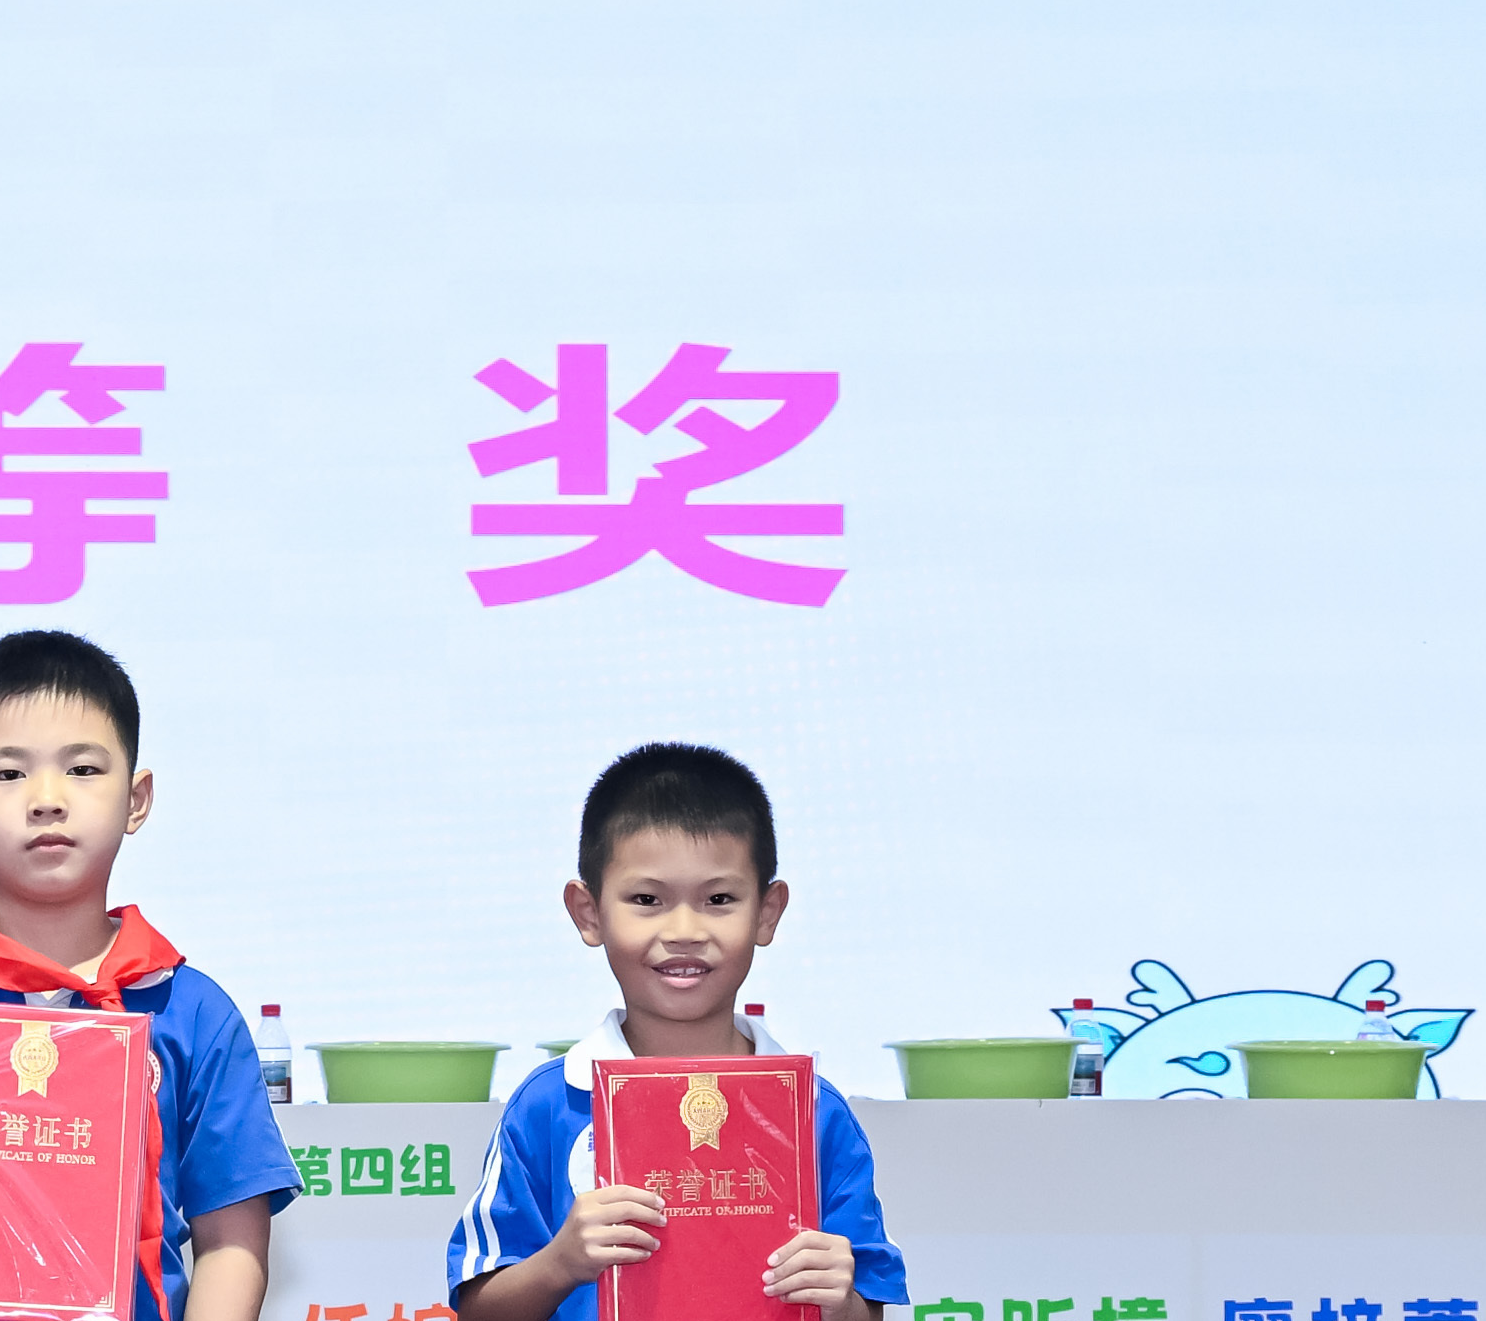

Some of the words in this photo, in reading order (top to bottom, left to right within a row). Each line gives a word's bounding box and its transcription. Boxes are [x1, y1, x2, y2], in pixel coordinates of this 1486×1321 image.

[37, 1152, 52, 1163] OF
[56, 1153, 96, 1165] HONOR
[288, 1143, 456, 1196] 第四组
[644, 1167, 768, 1202] 荣誉证书
[657, 1206, 712, 1217] TIFICATE
[734, 1205, 774, 1215] HONOR
